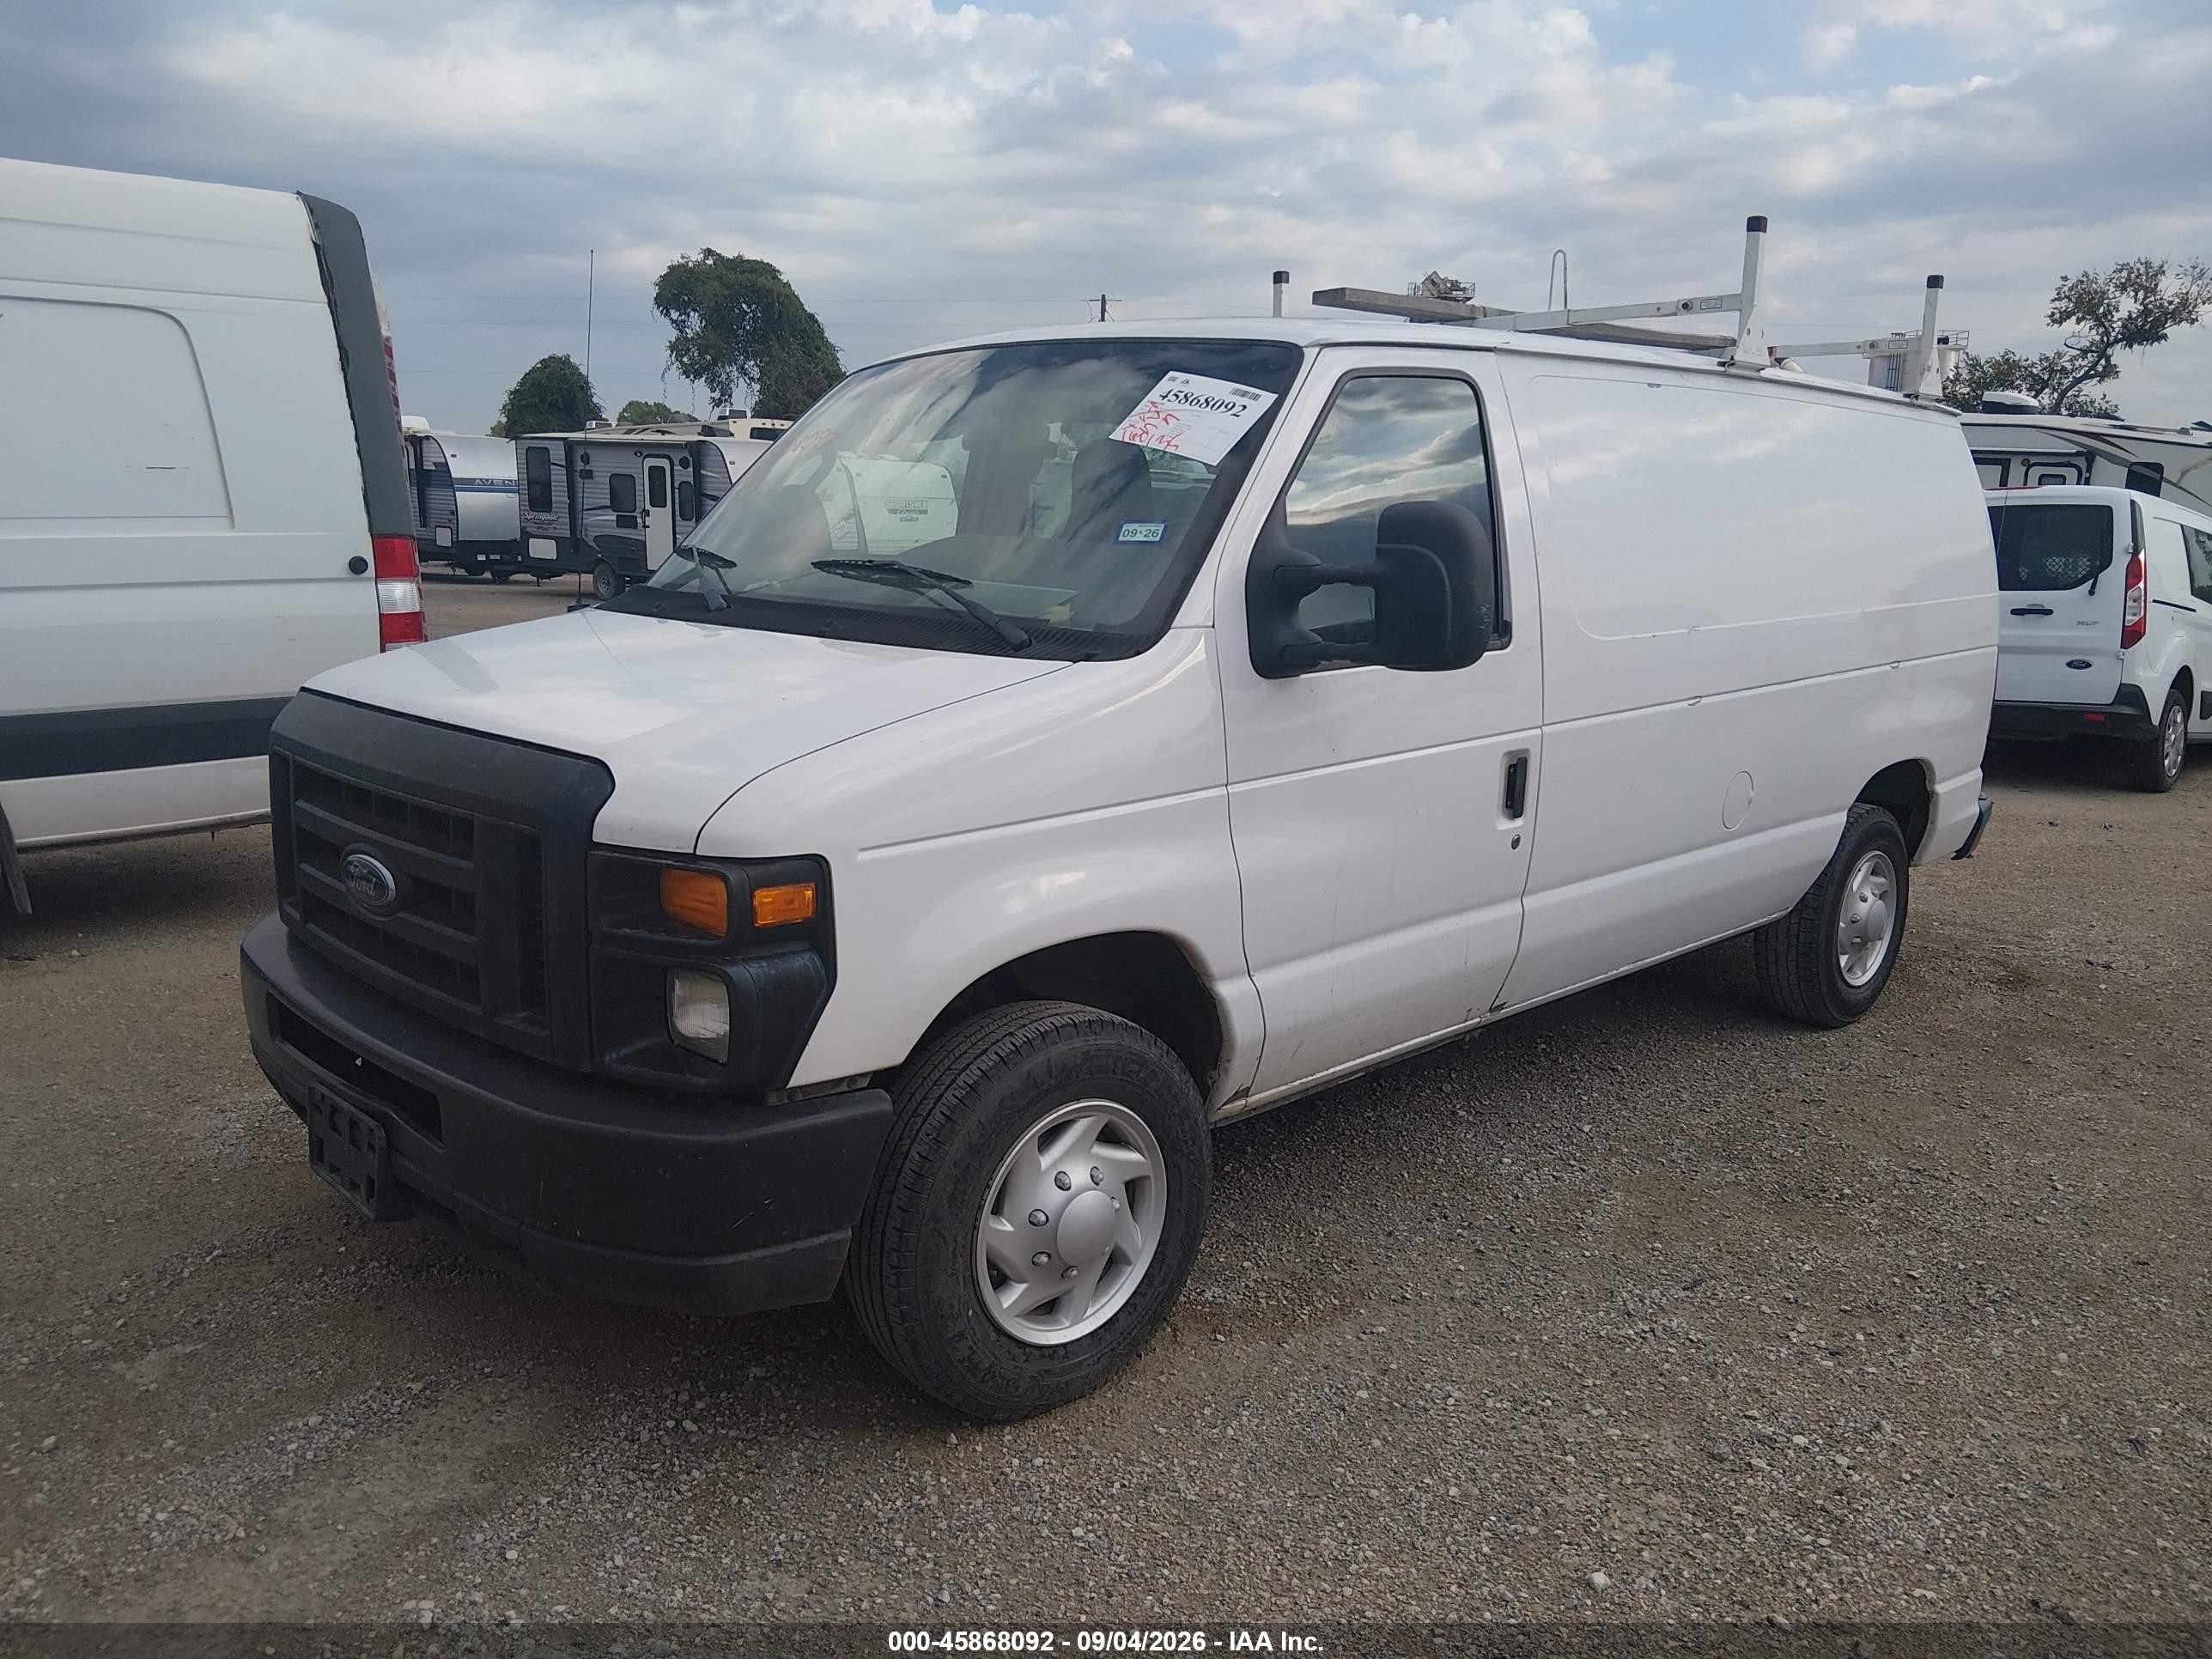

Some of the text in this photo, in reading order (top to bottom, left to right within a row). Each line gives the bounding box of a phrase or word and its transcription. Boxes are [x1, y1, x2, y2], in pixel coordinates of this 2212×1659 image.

[1159, 388, 1248, 418] 45868092
[1121, 528, 1160, 538] 09 26
[346, 861, 376, 896] Ford
